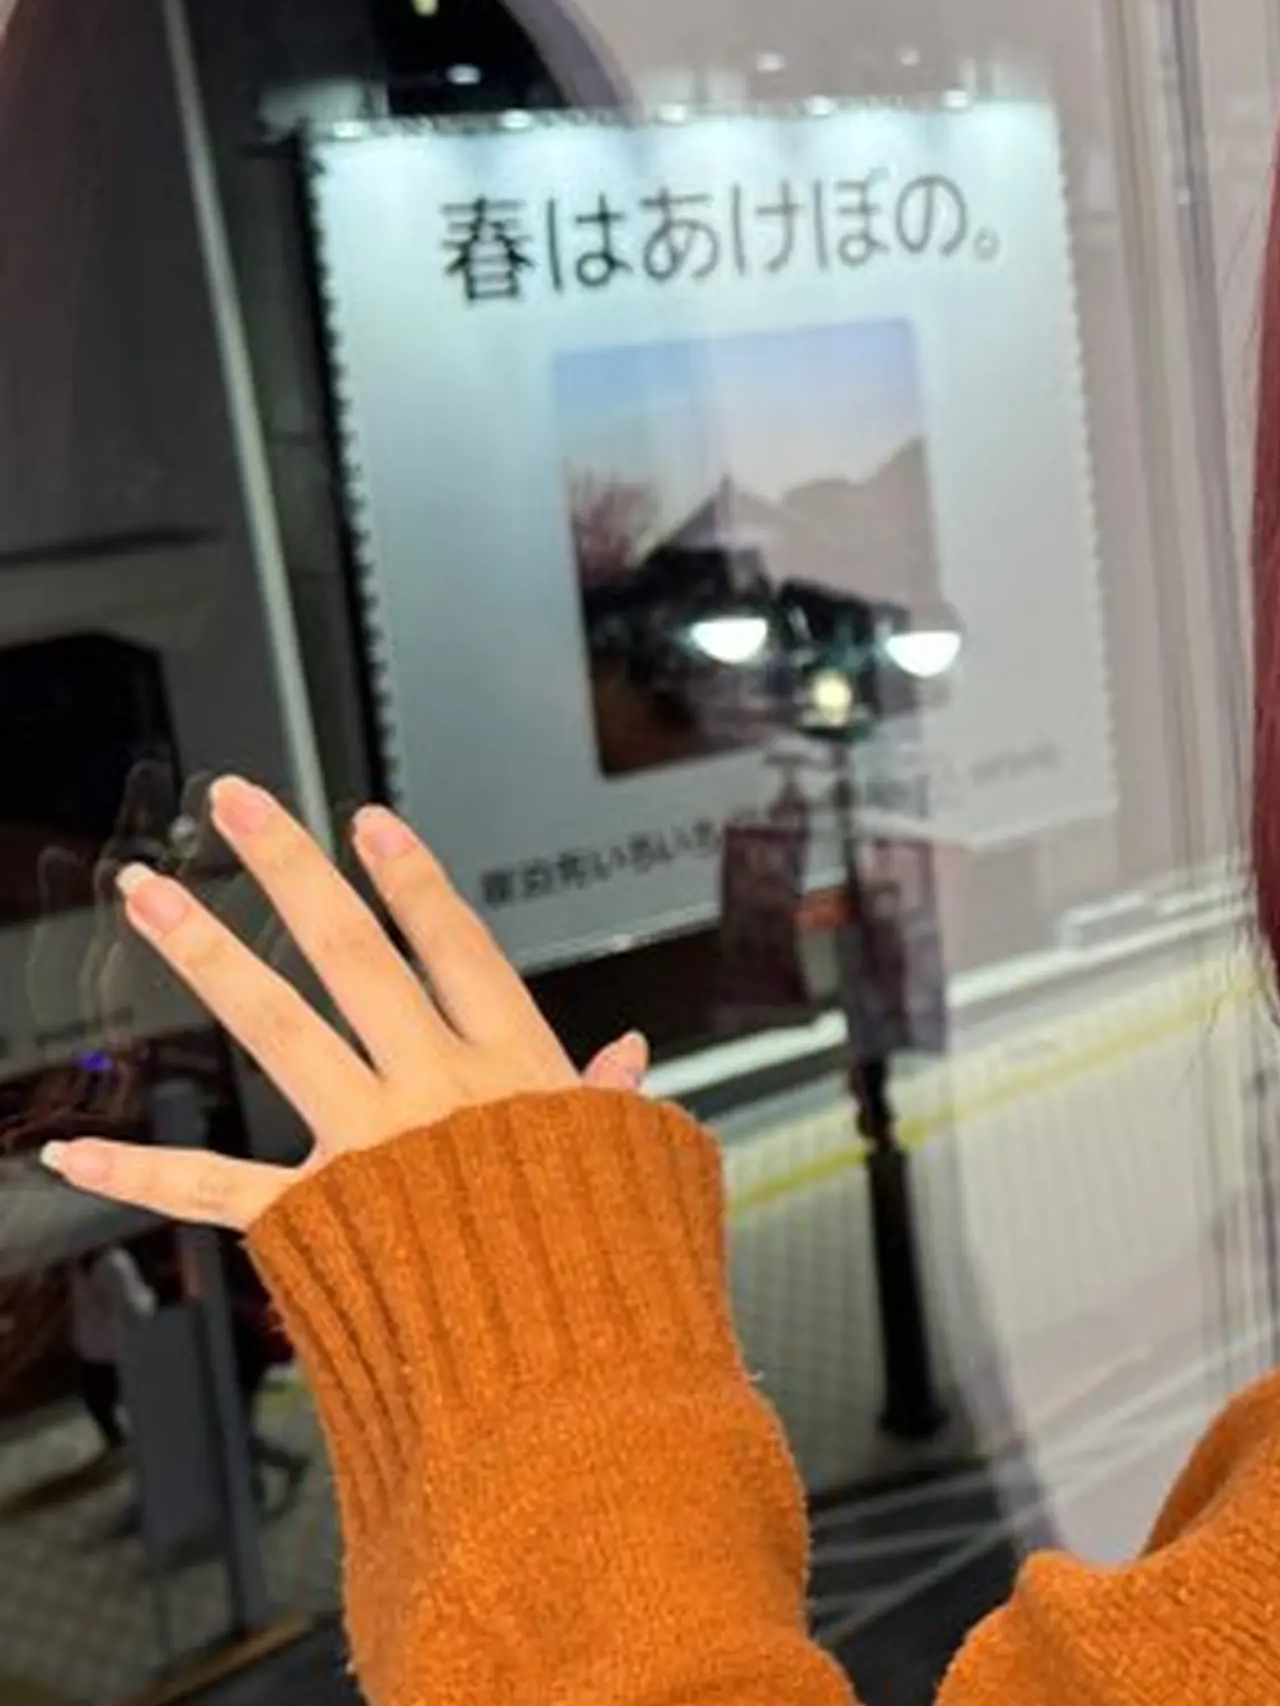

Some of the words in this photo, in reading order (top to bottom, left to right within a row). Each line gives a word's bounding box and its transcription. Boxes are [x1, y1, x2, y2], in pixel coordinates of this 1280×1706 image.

[440, 166, 1001, 305] 春はあけぼの。
